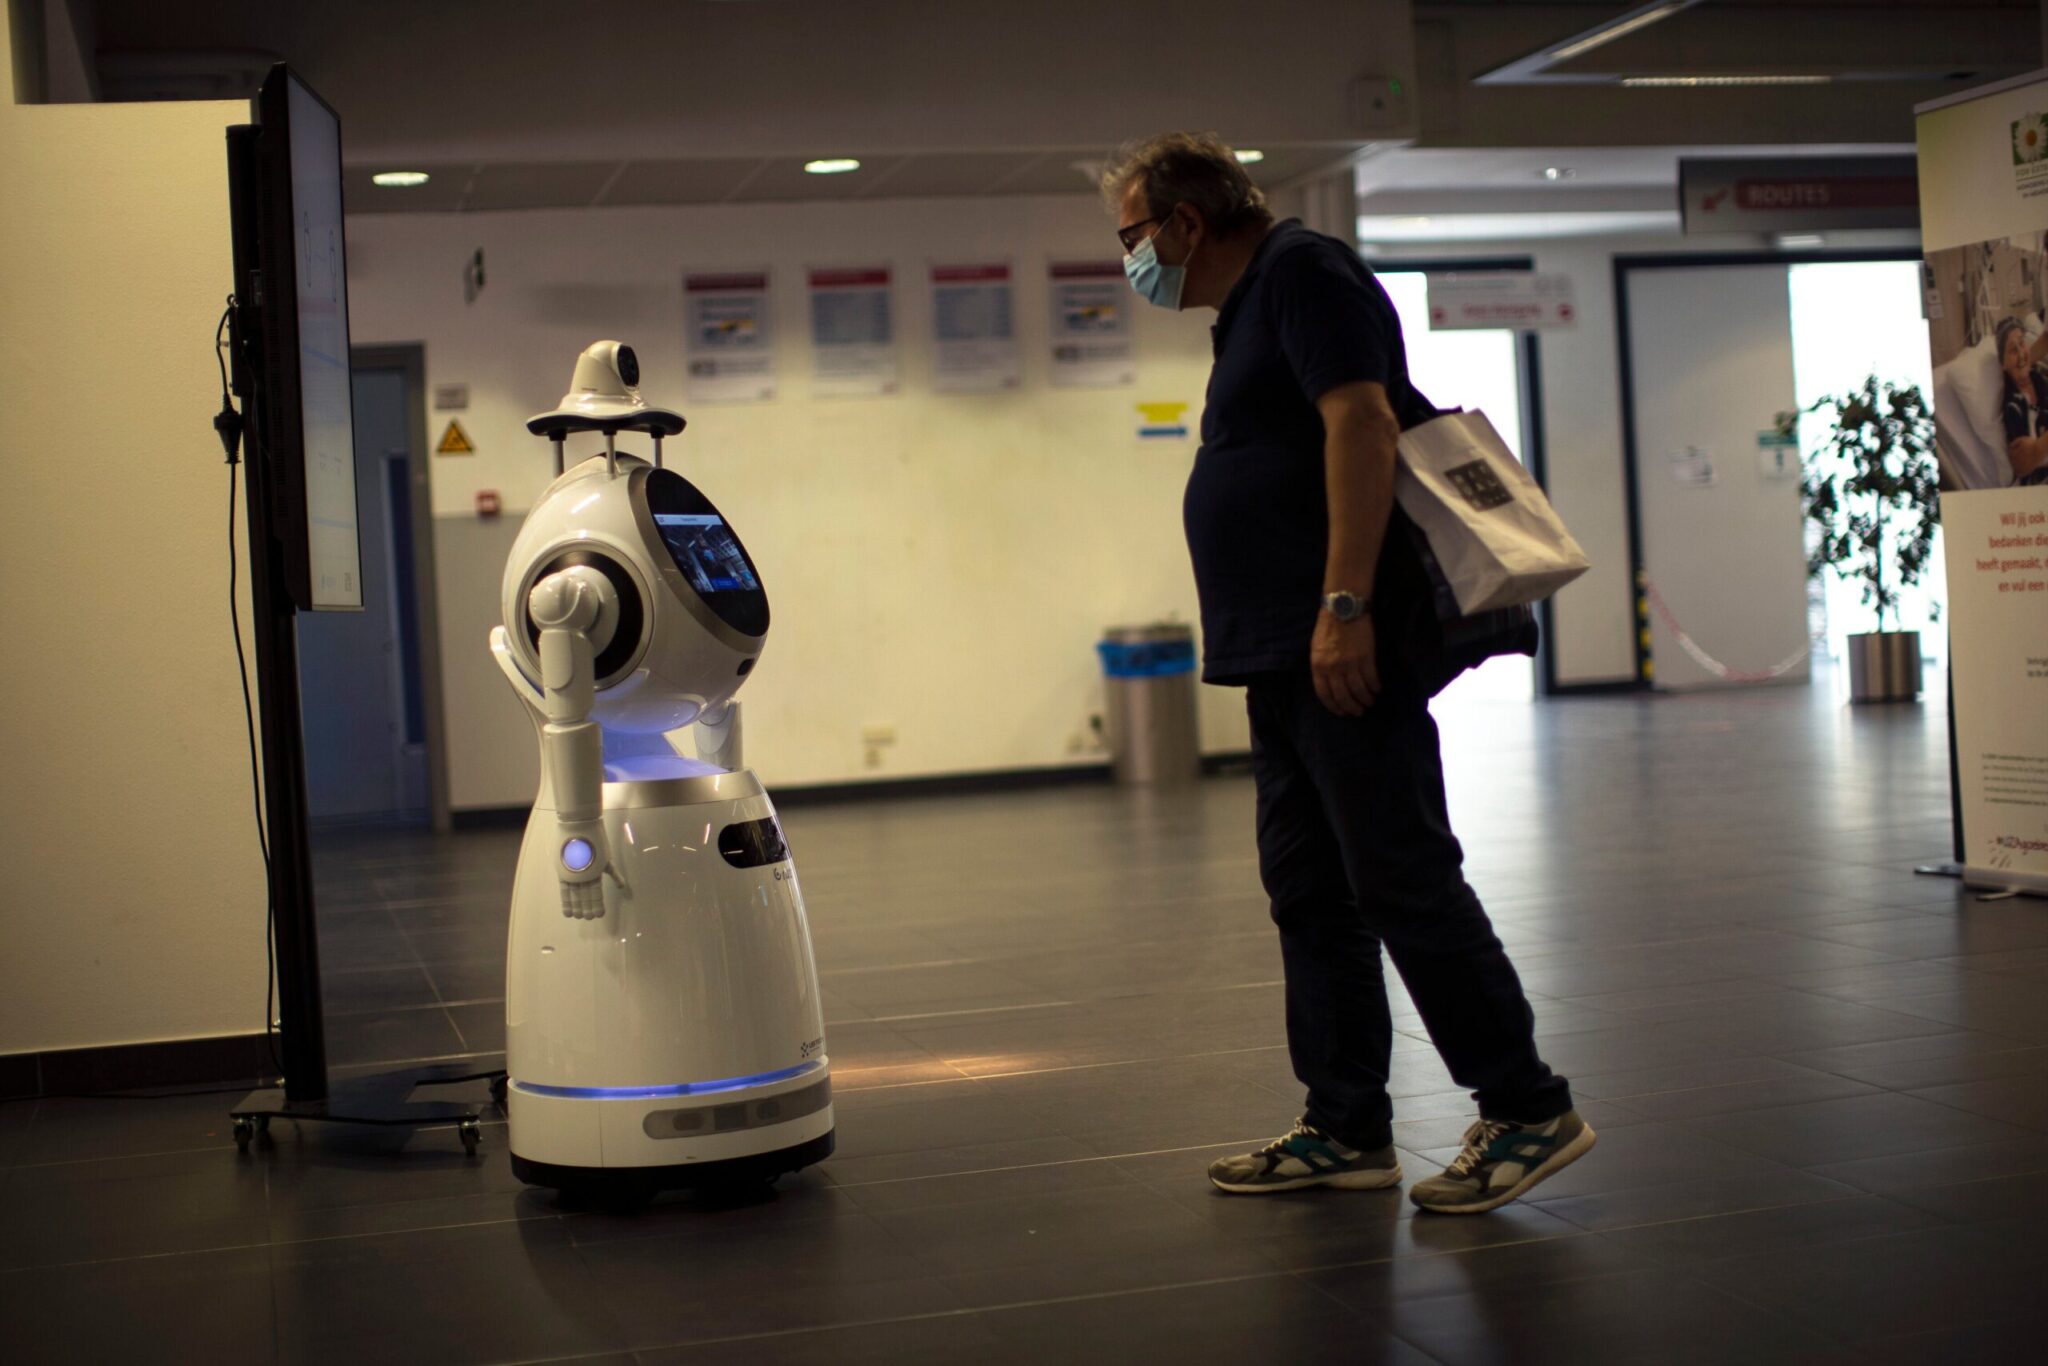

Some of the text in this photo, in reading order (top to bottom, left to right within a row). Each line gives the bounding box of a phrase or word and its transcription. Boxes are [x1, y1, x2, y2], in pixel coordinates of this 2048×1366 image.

[1748, 183, 1829, 206] ROUTES
[2028, 510, 2045, 524] ook
[1988, 534, 2033, 549] bedanken
[1976, 556, 2043, 573] heeft gemaakt,
[1998, 580, 2045, 593] en vul een
